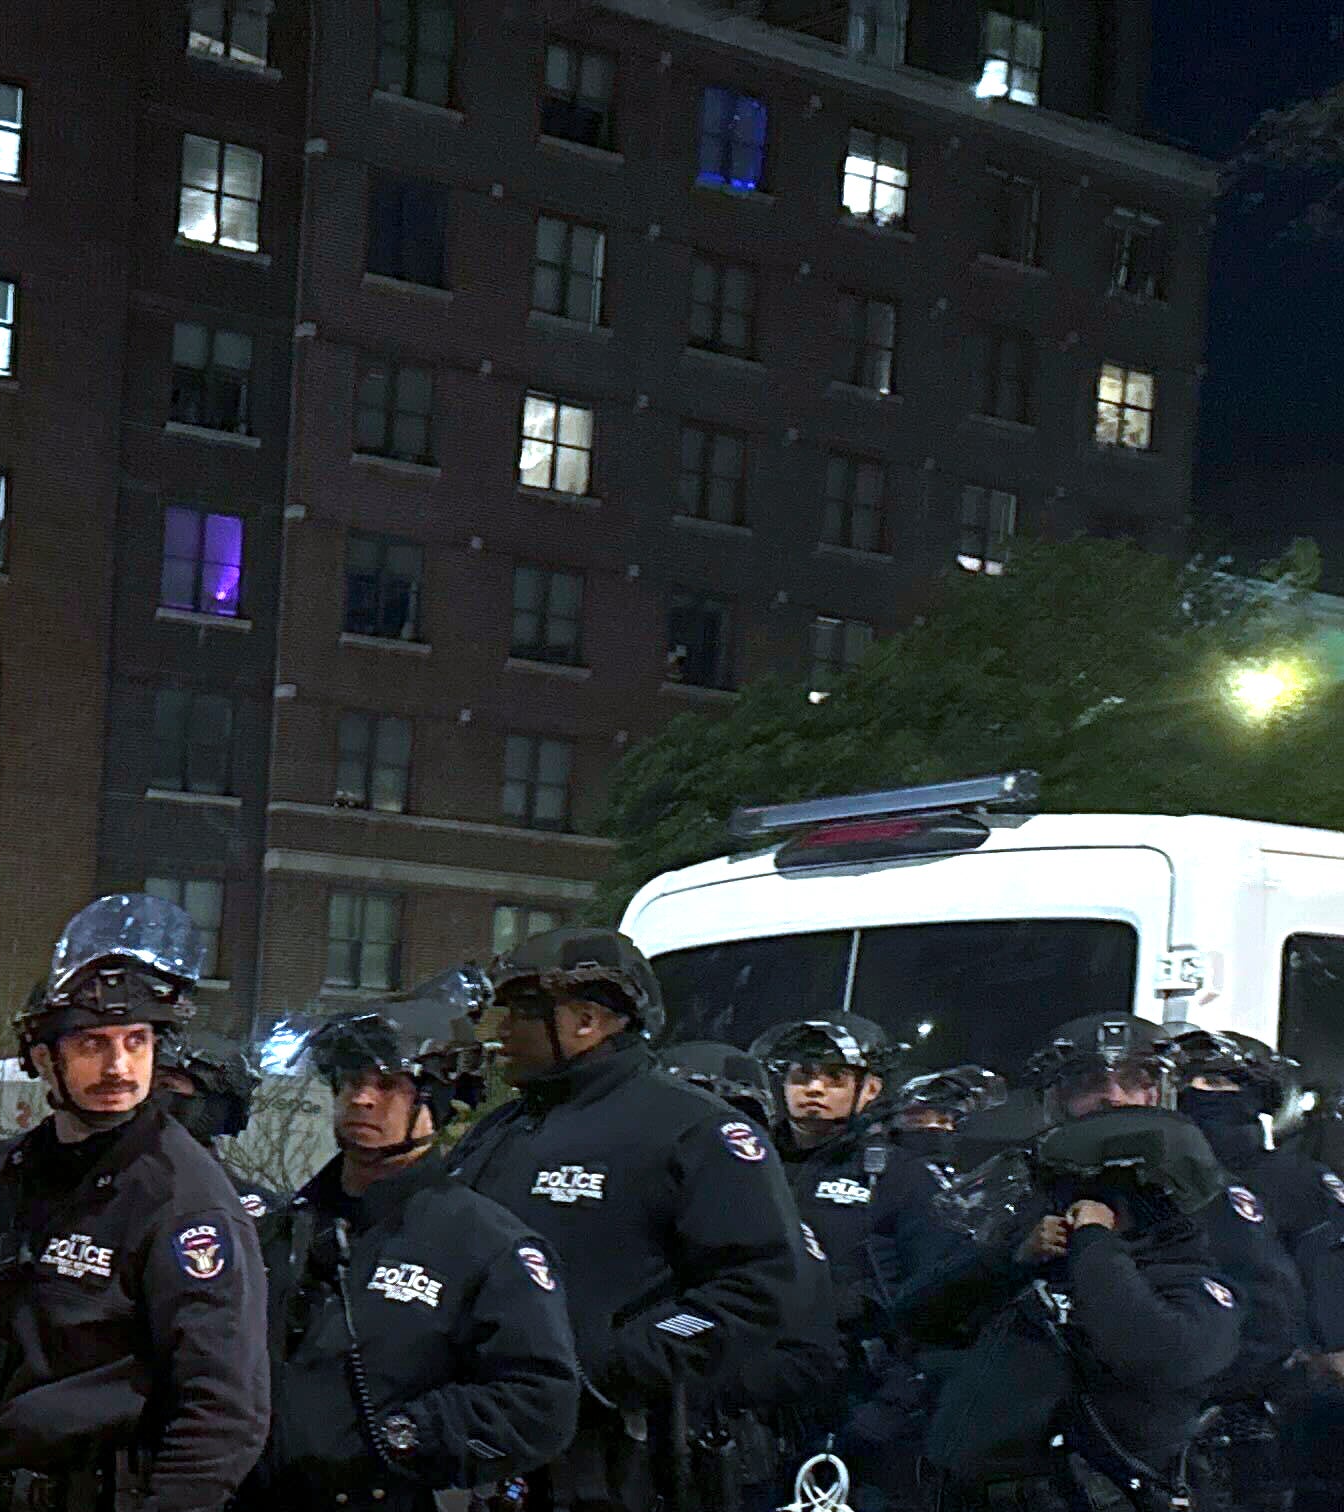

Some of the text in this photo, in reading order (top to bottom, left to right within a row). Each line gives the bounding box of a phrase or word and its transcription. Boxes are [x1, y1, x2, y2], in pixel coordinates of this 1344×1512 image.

[537, 1171, 605, 1190] POLICE
[180, 1225, 218, 1245] POLICE
[47, 1237, 114, 1267] POLICE
[372, 1266, 443, 1299] POLICE
